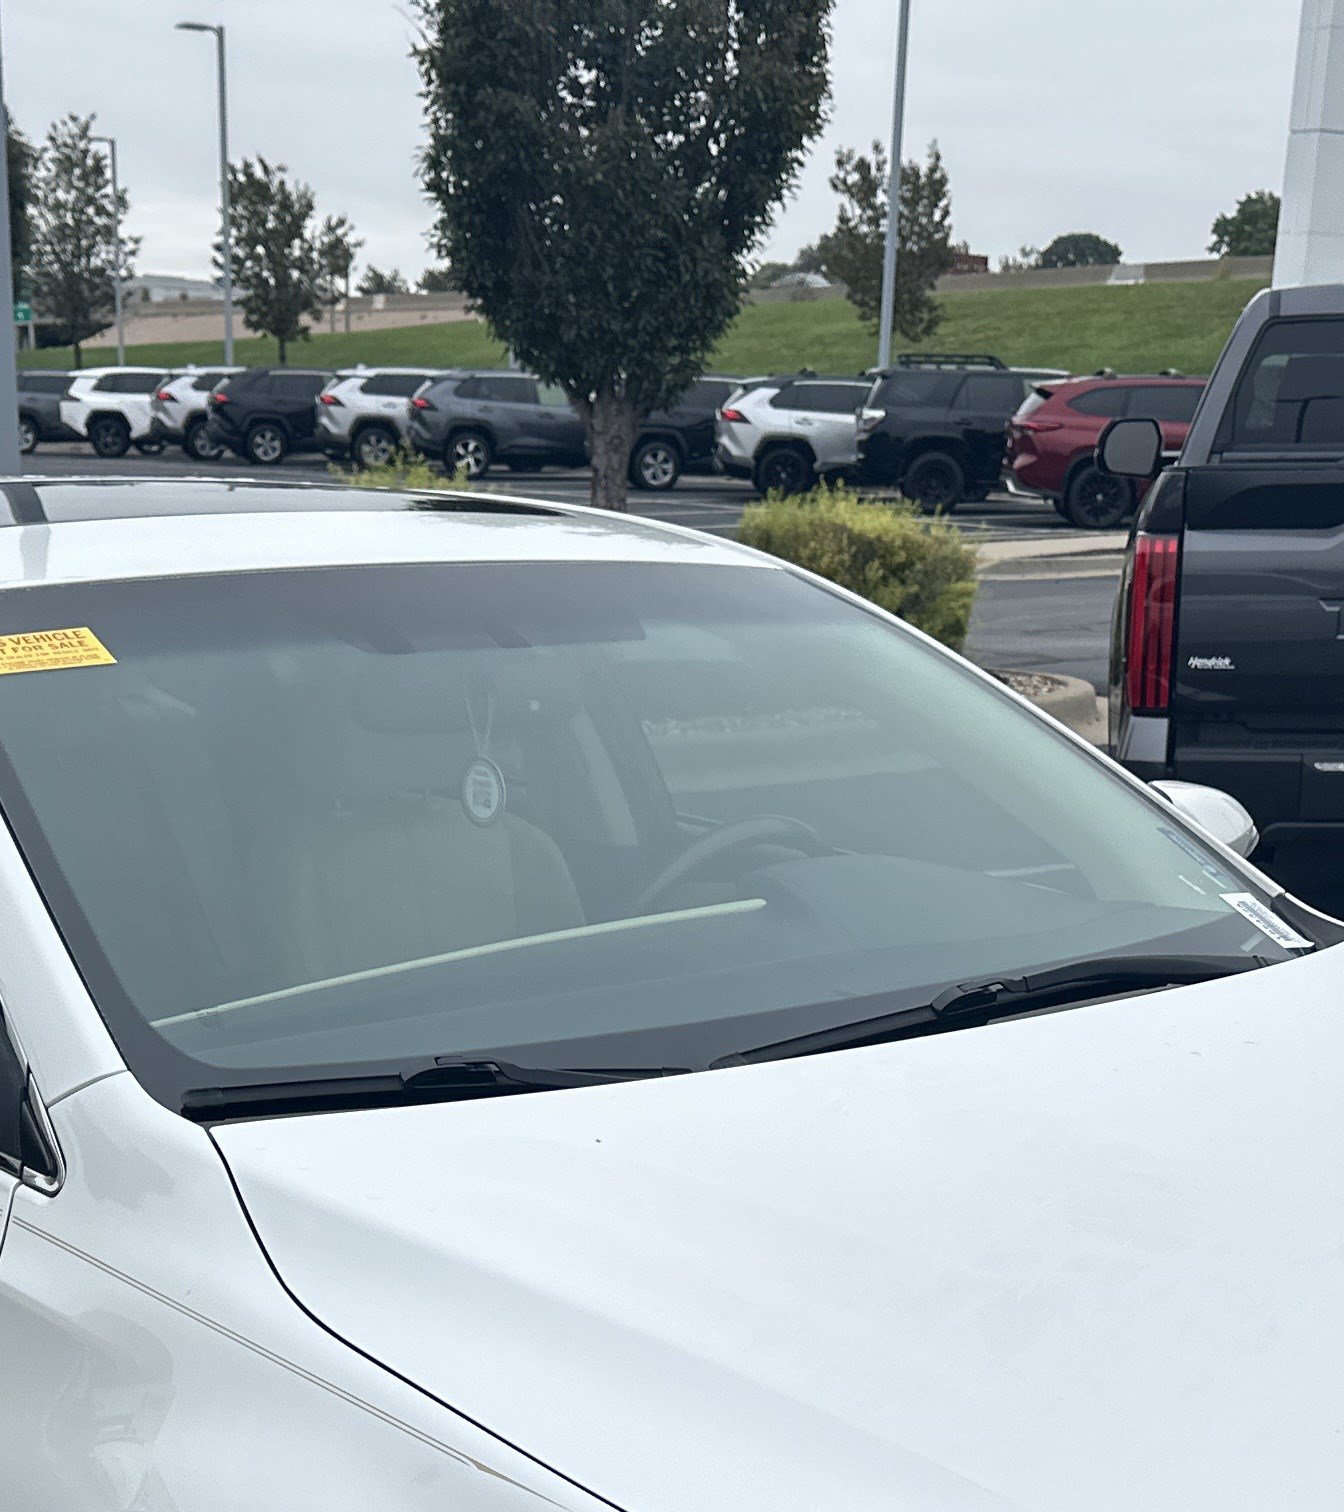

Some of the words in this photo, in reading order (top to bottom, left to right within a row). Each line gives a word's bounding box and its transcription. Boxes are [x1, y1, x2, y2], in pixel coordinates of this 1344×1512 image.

[9, 630, 87, 646] VEHICLE
[12, 644, 45, 654] FOR
[47, 639, 90, 650] SALE
